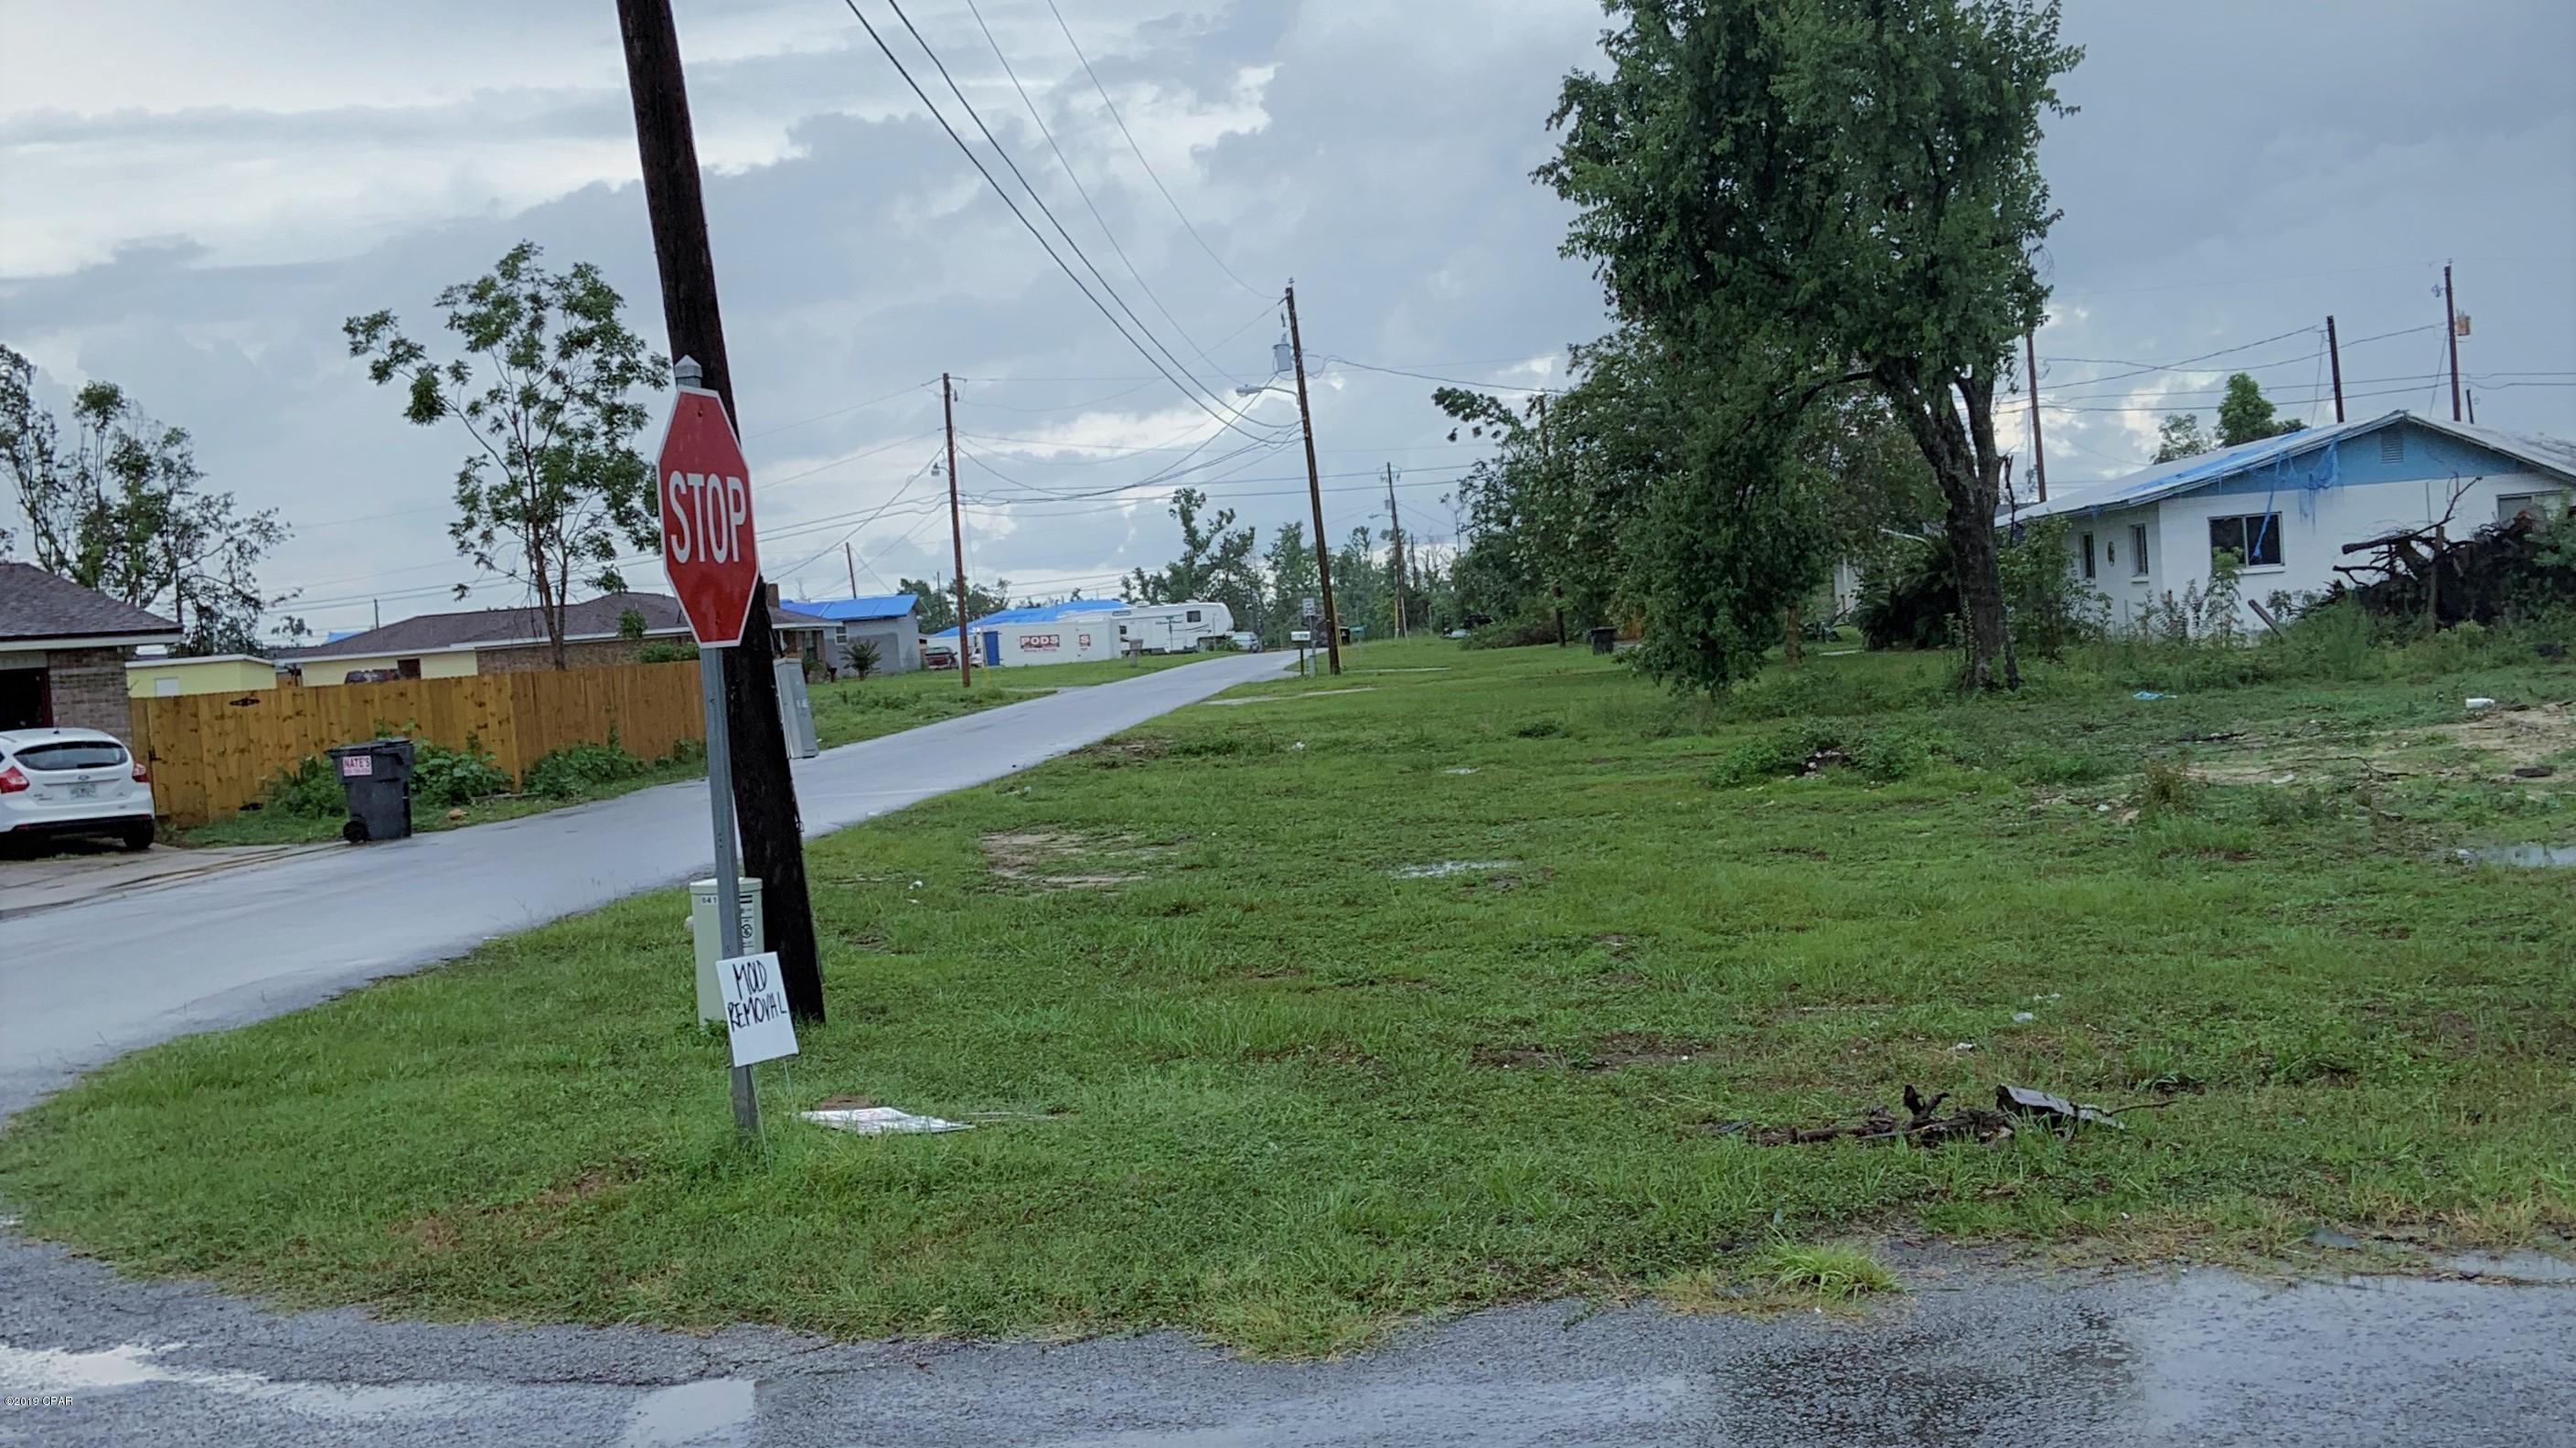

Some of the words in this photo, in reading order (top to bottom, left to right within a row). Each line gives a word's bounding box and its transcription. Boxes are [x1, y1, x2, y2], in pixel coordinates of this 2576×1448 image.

[668, 470, 747, 564] STOP
[1021, 635, 1059, 645] PODS
[344, 758, 370, 768] NATE'S
[727, 991, 787, 1033] REMOVAL
